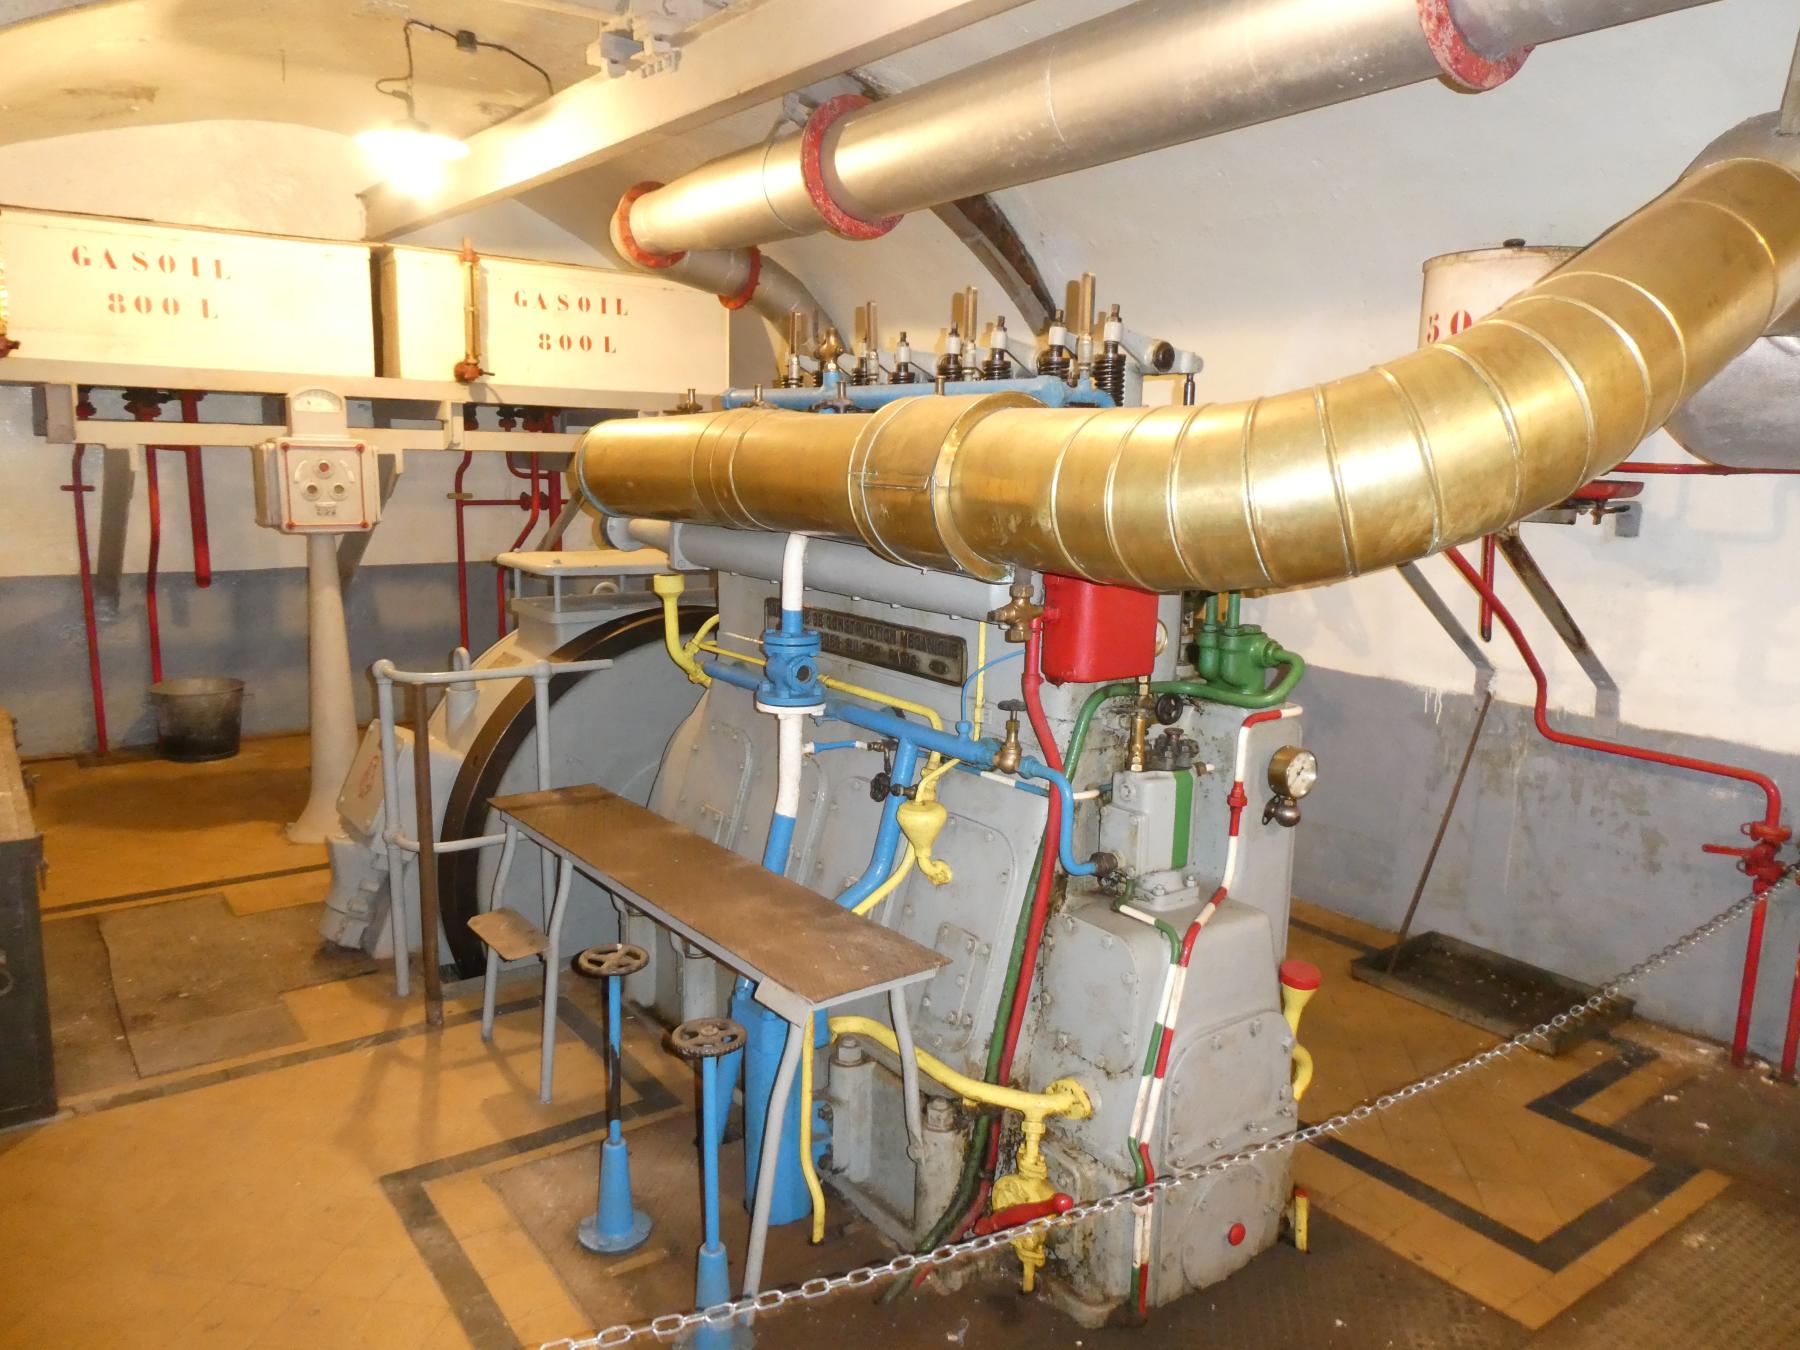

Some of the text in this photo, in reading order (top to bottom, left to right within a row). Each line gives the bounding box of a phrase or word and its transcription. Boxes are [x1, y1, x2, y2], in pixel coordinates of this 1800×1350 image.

[71, 246, 231, 280] GASOIL
[107, 293, 180, 316] 800
[513, 289, 629, 316] GASOIL
[538, 333, 593, 352] 800
